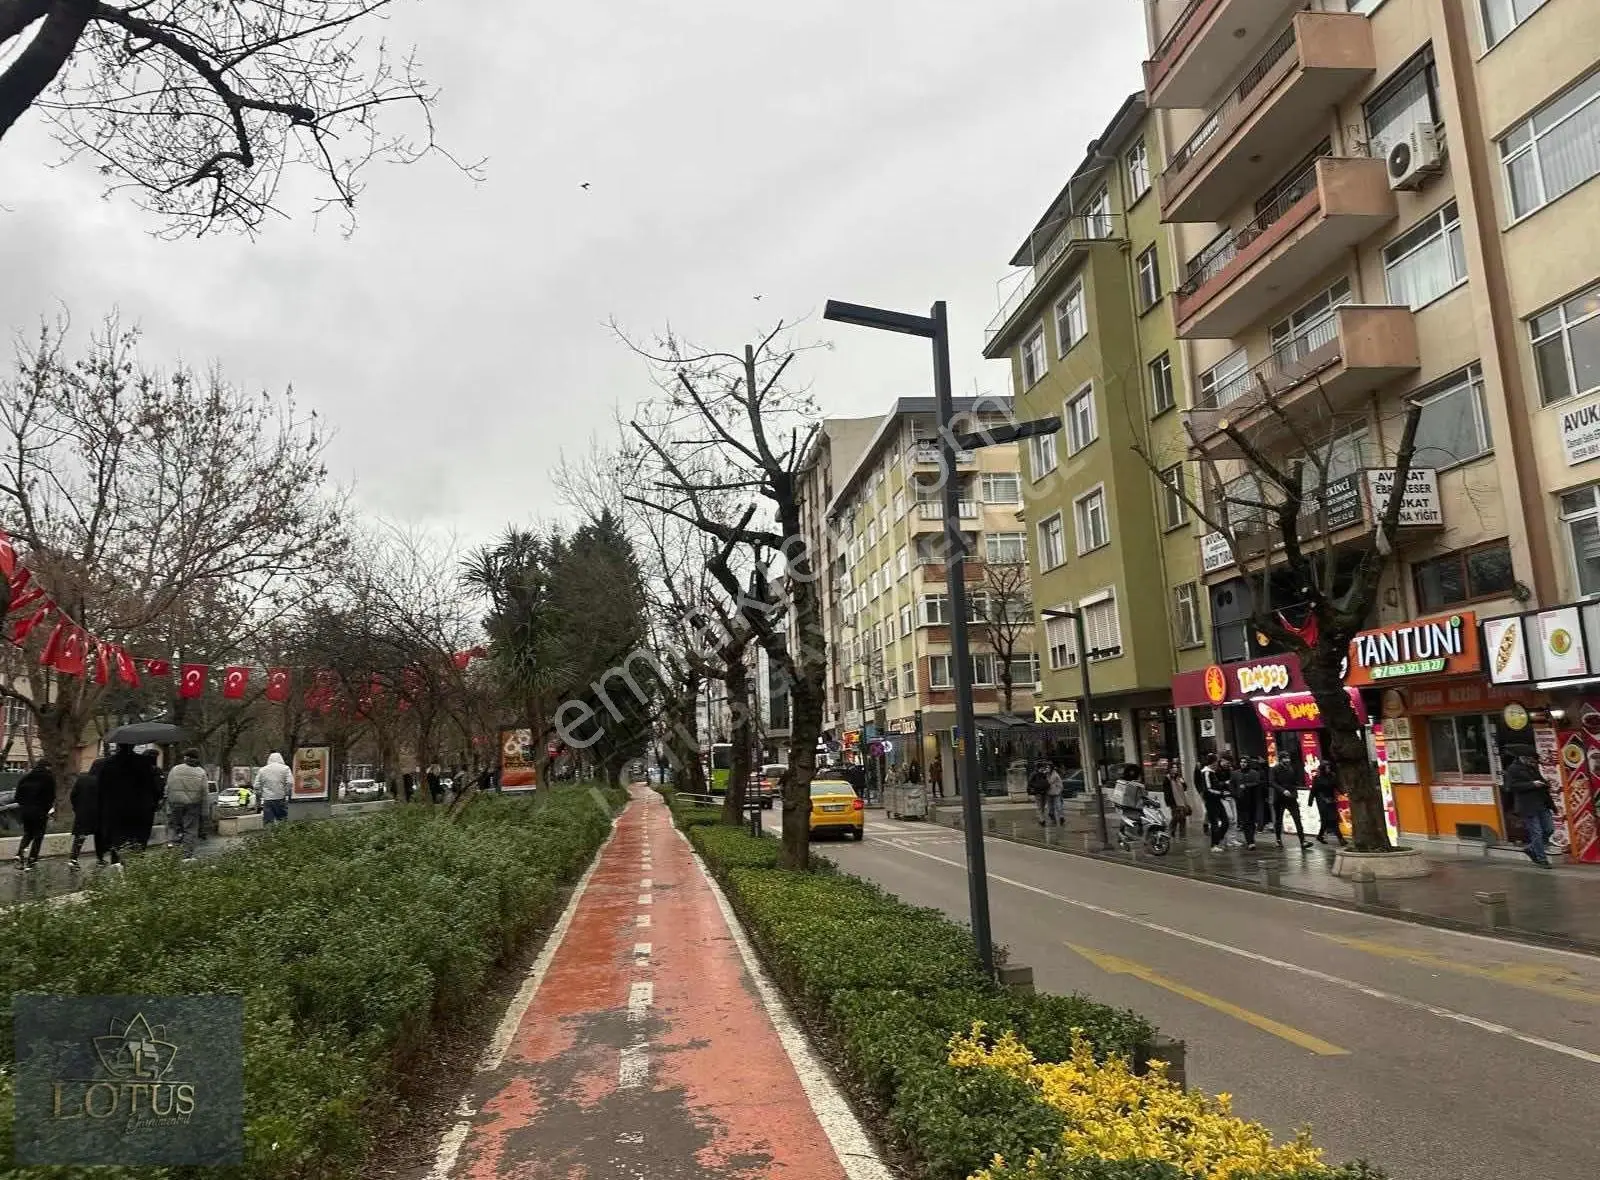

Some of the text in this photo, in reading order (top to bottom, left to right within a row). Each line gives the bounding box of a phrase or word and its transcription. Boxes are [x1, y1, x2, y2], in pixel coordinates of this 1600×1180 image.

[1564, 405, 1600, 434] AVUK
[1378, 471, 1424, 481] AVKAT
[1383, 499, 1430, 509] AUKAT
